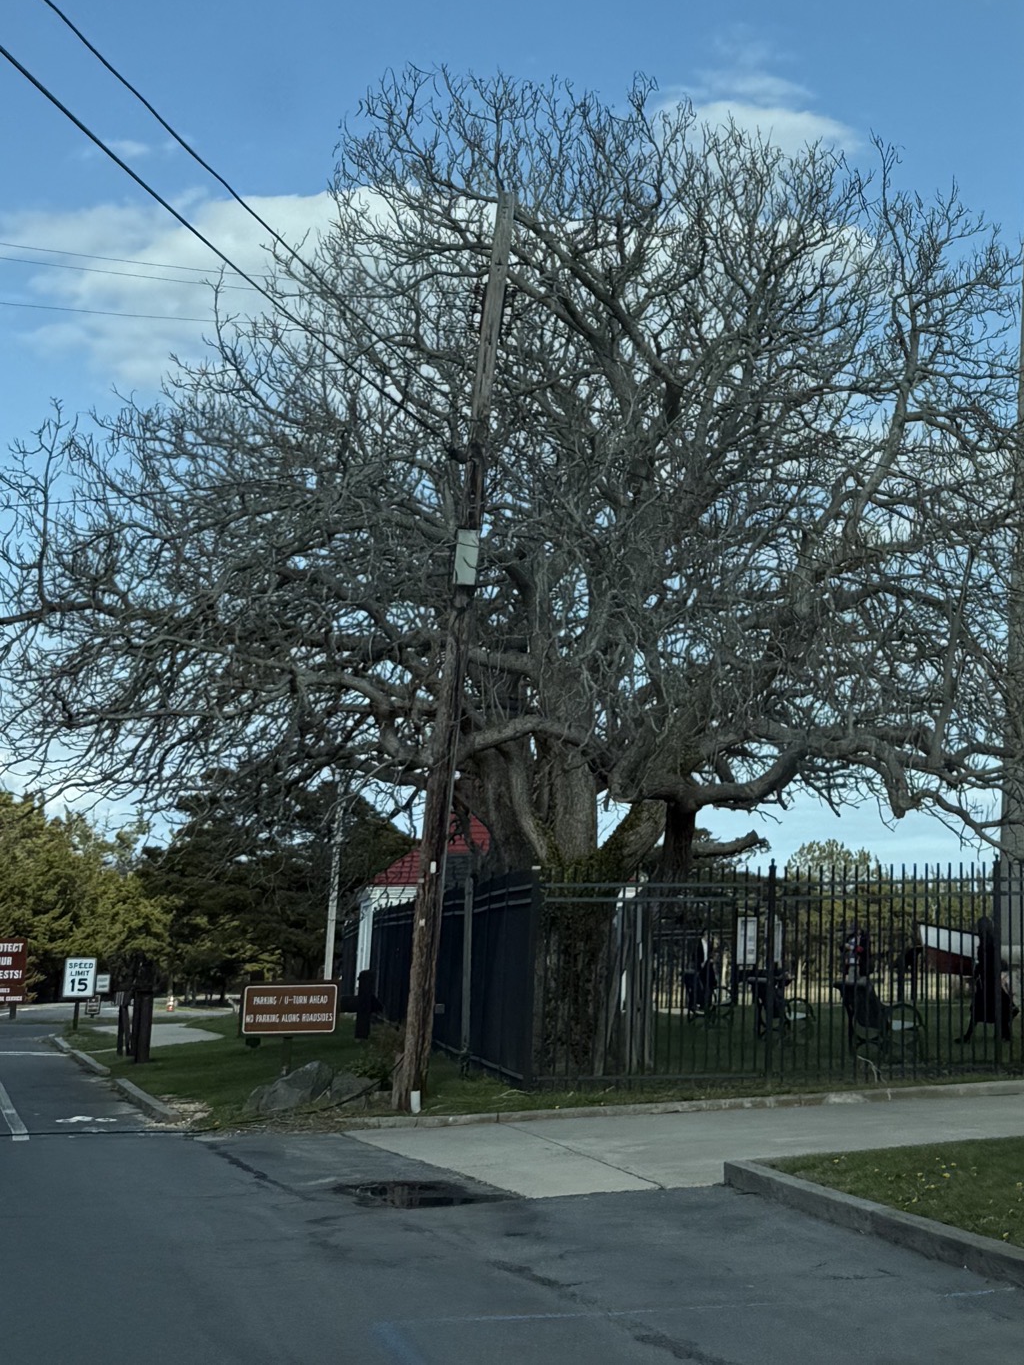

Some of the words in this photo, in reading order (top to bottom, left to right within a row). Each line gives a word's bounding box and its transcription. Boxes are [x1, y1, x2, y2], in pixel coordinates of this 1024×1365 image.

[71, 978, 88, 992] 15
[253, 996, 277, 1005] PARKING
[284, 995, 307, 1004] U-TURN
[309, 995, 328, 1004] AHEAD
[246, 1014, 254, 1023] NO
[256, 1014, 279, 1023] PARKING
[282, 1013, 300, 1022] ALONG
[302, 1013, 333, 1022] ROADSIDES
